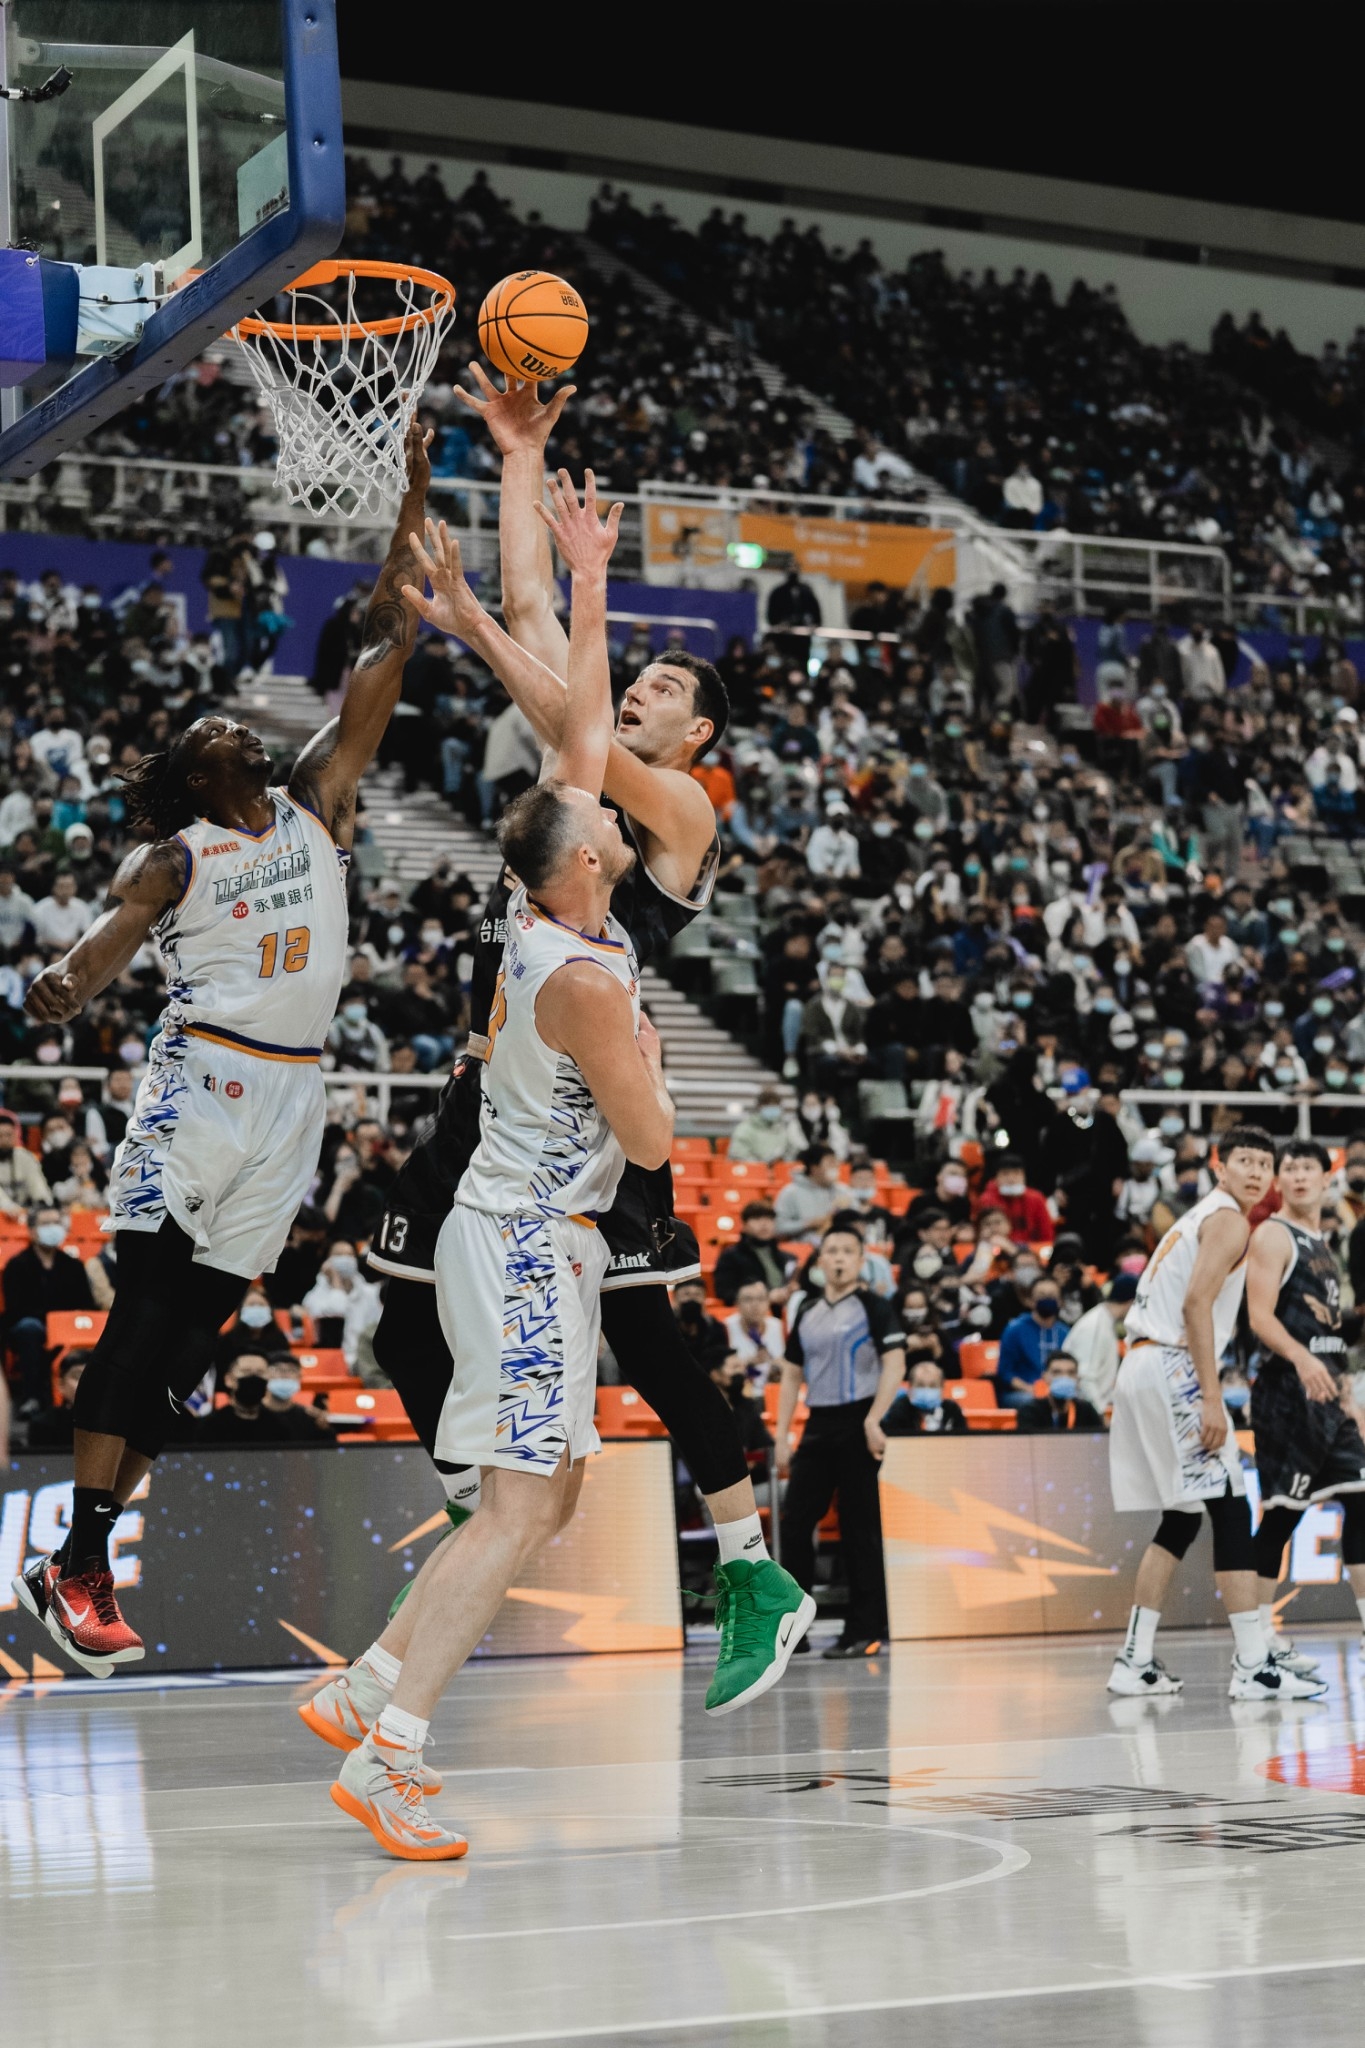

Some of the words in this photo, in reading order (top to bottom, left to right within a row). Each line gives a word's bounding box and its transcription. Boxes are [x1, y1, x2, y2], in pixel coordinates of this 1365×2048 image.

[560, 295, 579, 308] FIBA
[213, 843, 312, 905] LEOPARDS
[254, 884, 314, 913] 永豐銀行
[257, 925, 311, 978] 12
[380, 1211, 409, 1253] 13
[1289, 1472, 1312, 1499] 12
